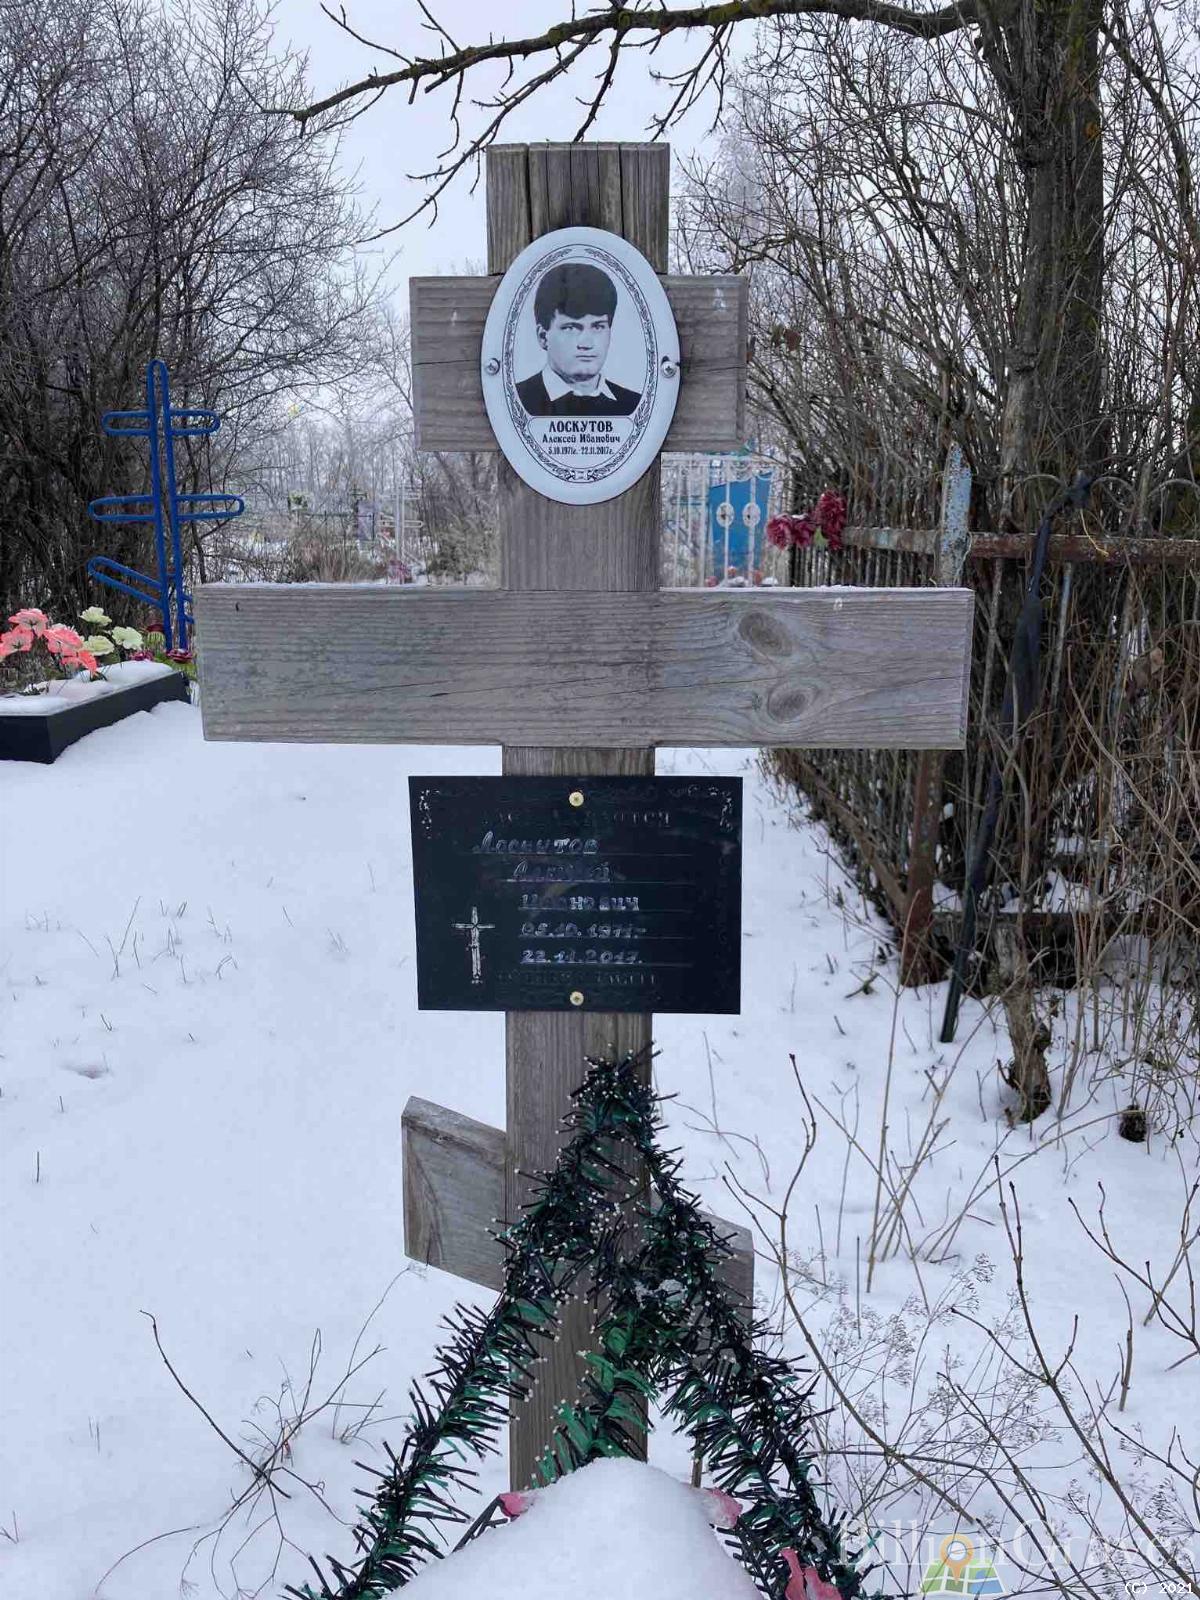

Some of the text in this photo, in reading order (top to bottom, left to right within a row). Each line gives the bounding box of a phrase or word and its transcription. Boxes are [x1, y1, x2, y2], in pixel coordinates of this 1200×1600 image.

[549, 420, 613, 433] ЛОСКУТОВ
[542, 433, 621, 443] Алексей Иванович
